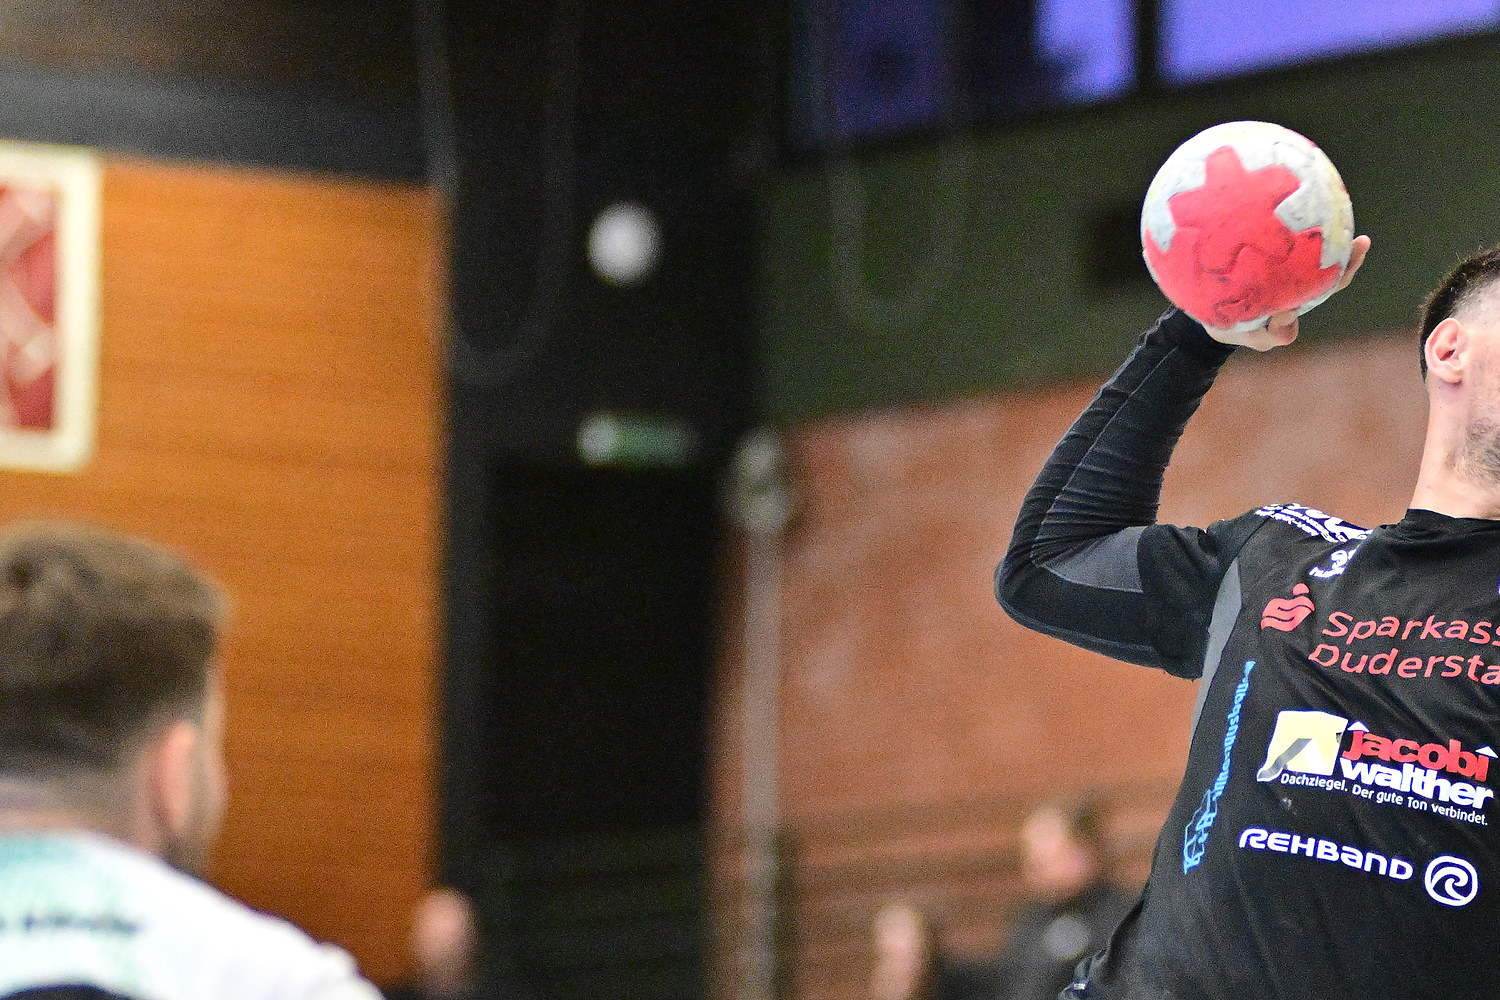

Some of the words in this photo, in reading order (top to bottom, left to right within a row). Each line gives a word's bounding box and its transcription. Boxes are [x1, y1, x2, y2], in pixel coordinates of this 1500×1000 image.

[1341, 721, 1498, 782] jacobi
[1280, 772, 1348, 792] Dachziegel.
[1351, 783, 1375, 800] Der
[1376, 790, 1404, 806] gute
[1406, 796, 1428, 812] Ton
[1430, 803, 1489, 826] verbindet.
[1339, 757, 1495, 810] walther
